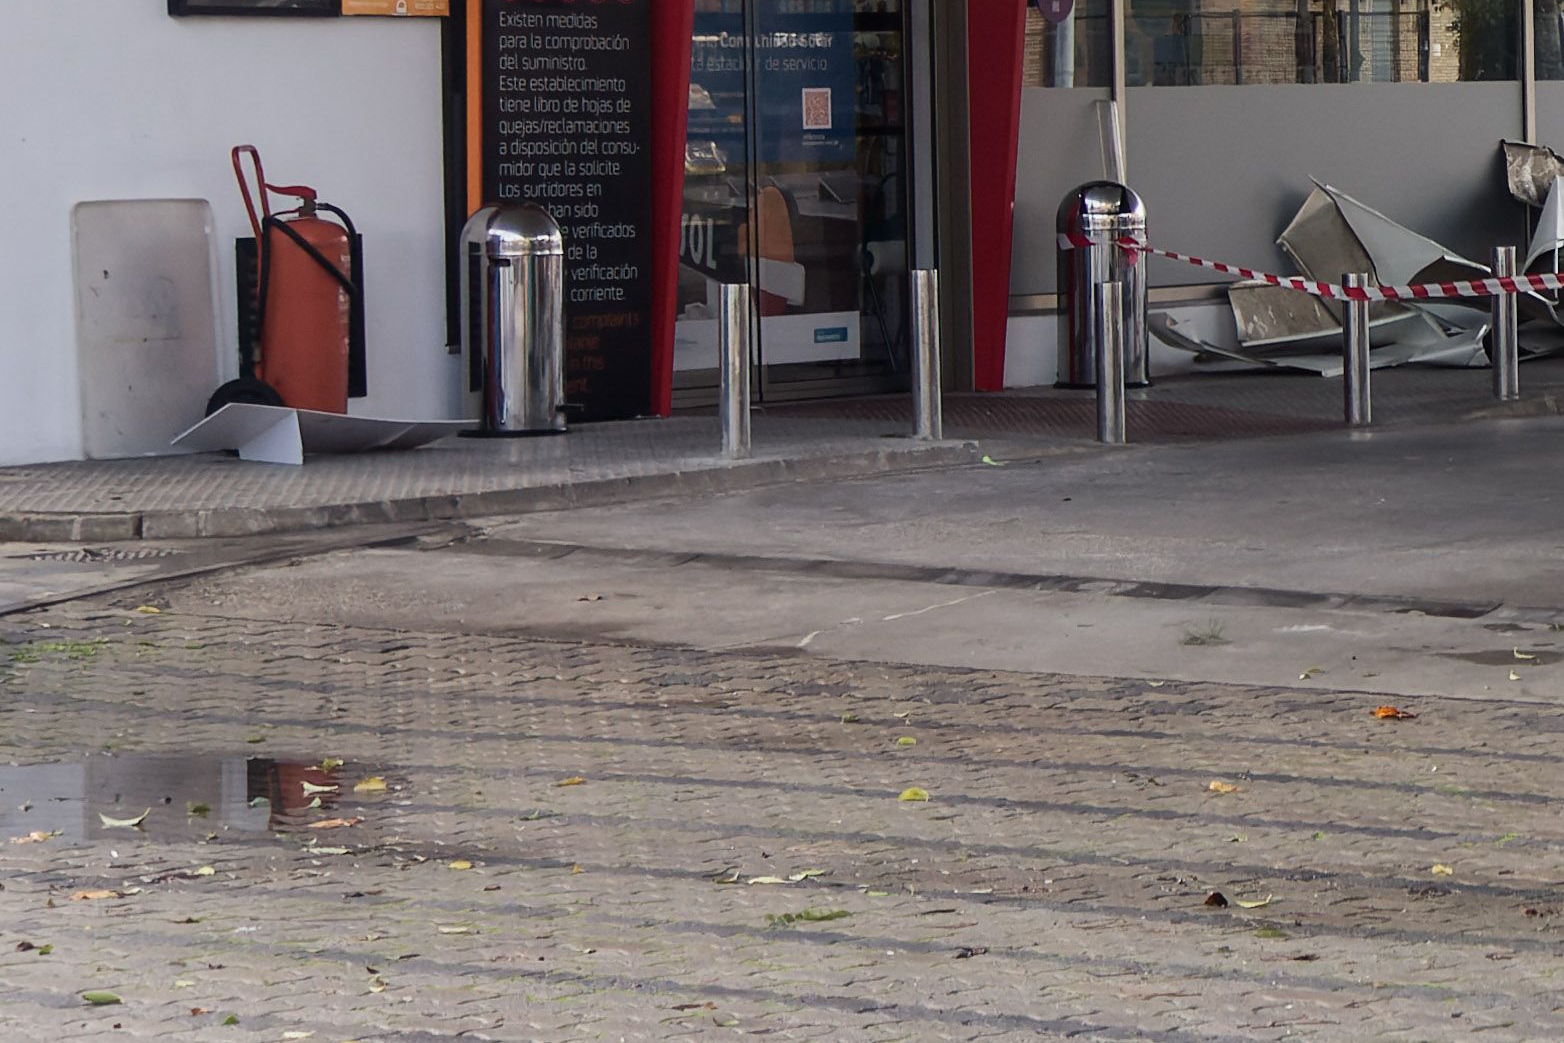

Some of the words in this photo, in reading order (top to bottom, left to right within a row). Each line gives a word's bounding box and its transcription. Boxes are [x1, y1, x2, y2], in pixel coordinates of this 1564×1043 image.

[499, 11, 543, 28] Existen
[546, 12, 598, 29] medidas
[499, 35, 527, 52] para
[530, 33, 542, 49] la
[545, 33, 630, 52] comprobación
[499, 53, 519, 70] del
[499, 75, 527, 91] Este
[529, 75, 626, 93] establecimiento
[499, 96, 531, 113] tiene
[534, 95, 561, 113] libro
[563, 95, 580, 113] de
[581, 95, 614, 117] hojas
[616, 96, 632, 113] de
[499, 117, 631, 138] quejas/reclamaciones
[499, 141, 508, 156] a
[510, 137, 578, 158] disposición
[580, 138, 599, 156] del
[499, 160, 535, 176] midor
[538, 161, 562, 178] que
[564, 160, 577, 176] la
[499, 182, 521, 198] Los
[523, 181, 584, 198] surtidores
[586, 182, 602, 197] en
[547, 202, 572, 218] han
[574, 200, 599, 218] sido
[571, 221, 636, 239] verificados
[567, 242, 584, 261] de
[586, 243, 598, 260] la
[571, 262, 639, 281] verificación
